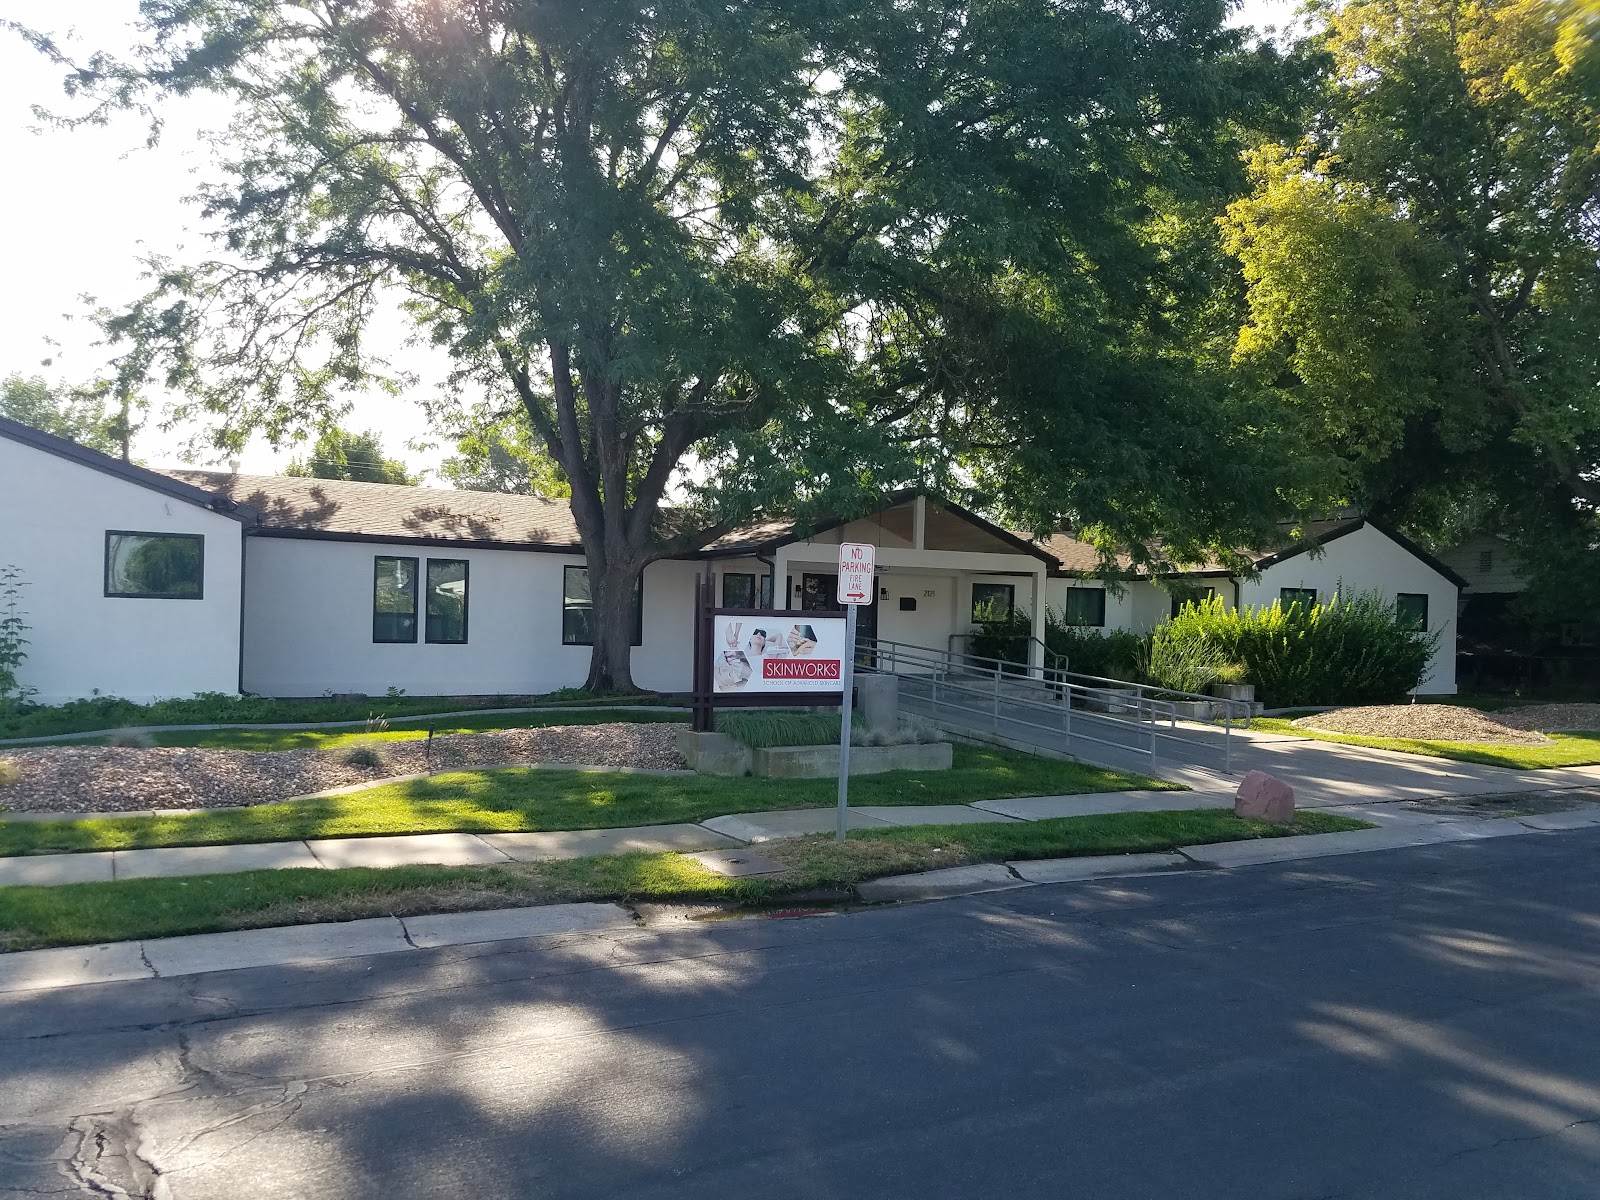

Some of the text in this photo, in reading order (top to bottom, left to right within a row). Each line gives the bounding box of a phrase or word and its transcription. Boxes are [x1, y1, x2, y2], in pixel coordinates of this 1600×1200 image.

[851, 548, 863, 560] NO
[842, 561, 871, 573] PARKING
[849, 574, 862, 582] FIRE
[848, 582, 862, 590] LANE
[766, 662, 838, 677] SKINWORKS
